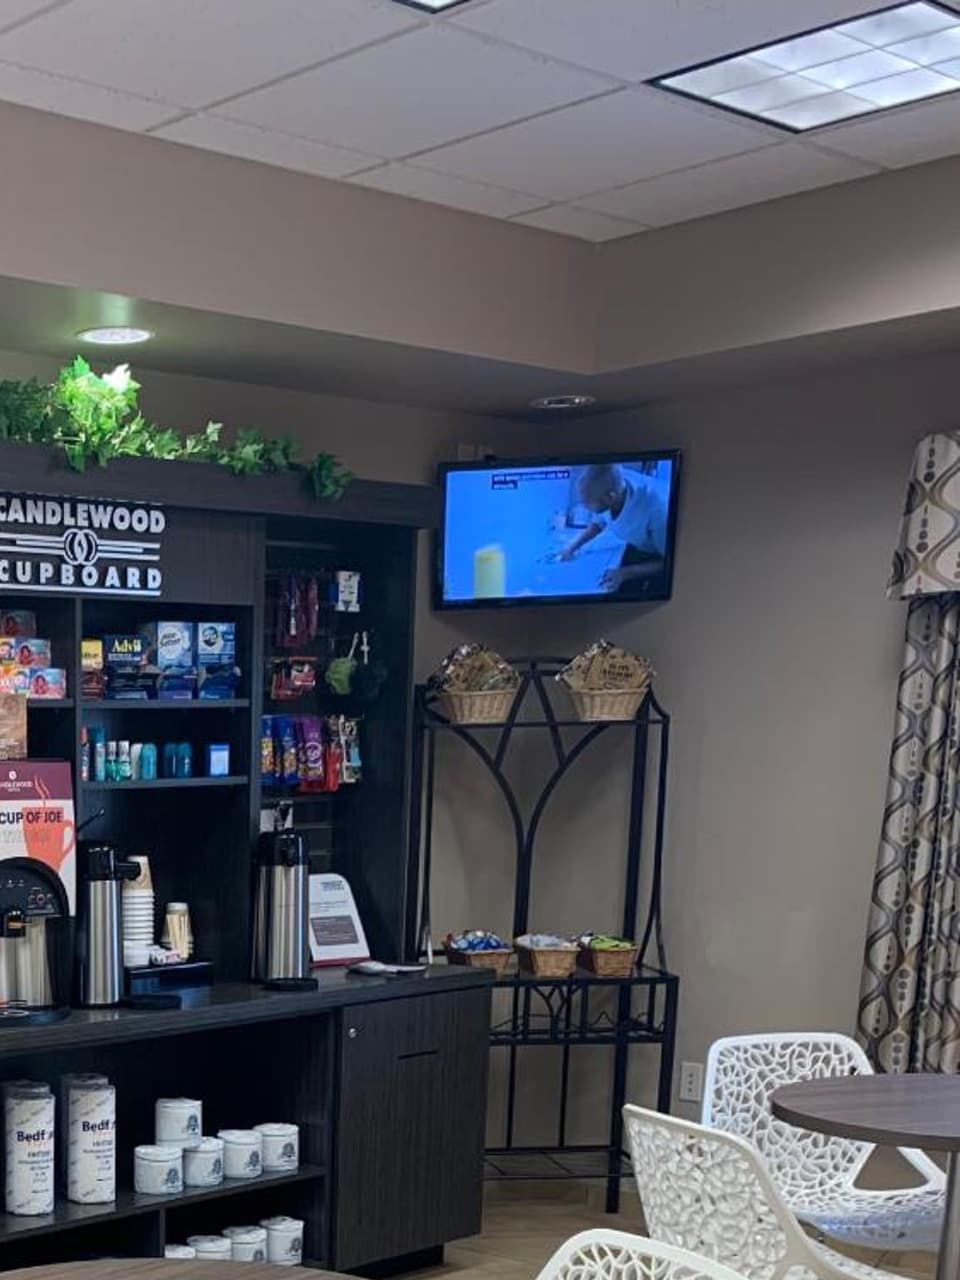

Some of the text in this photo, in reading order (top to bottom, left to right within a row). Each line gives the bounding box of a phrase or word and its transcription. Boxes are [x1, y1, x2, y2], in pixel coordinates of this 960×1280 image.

[112, 639, 142, 653] Advil
[26, 811, 41, 824] OF
[43, 811, 65, 824] JOE
